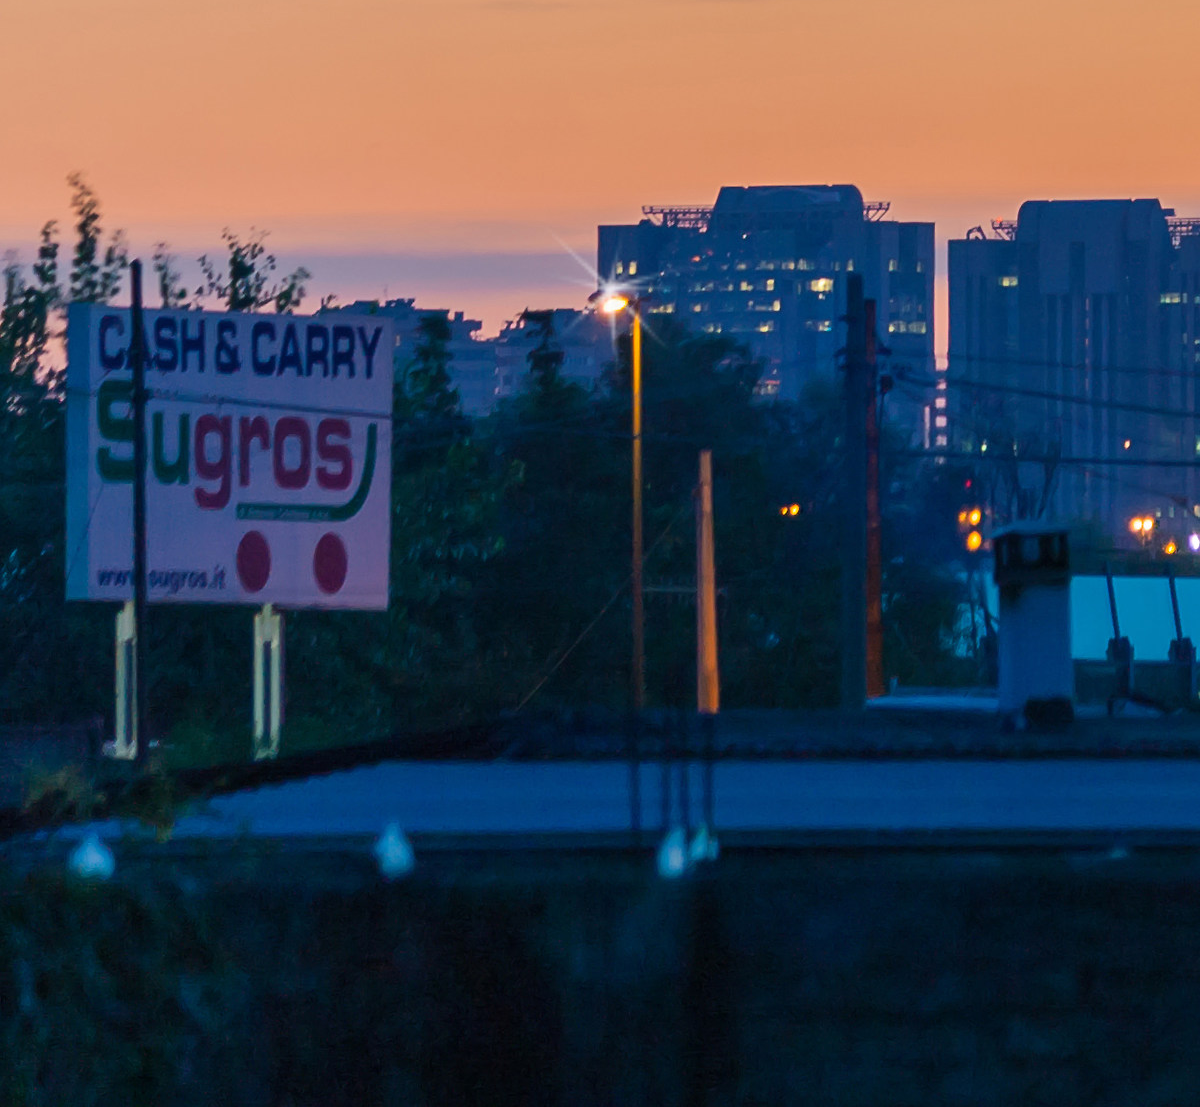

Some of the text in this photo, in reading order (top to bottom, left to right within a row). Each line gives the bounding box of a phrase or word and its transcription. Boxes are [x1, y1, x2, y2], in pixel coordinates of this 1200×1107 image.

[213, 319, 241, 374] &
[251, 321, 383, 380] CARRY
[95, 379, 354, 511] Sugros
